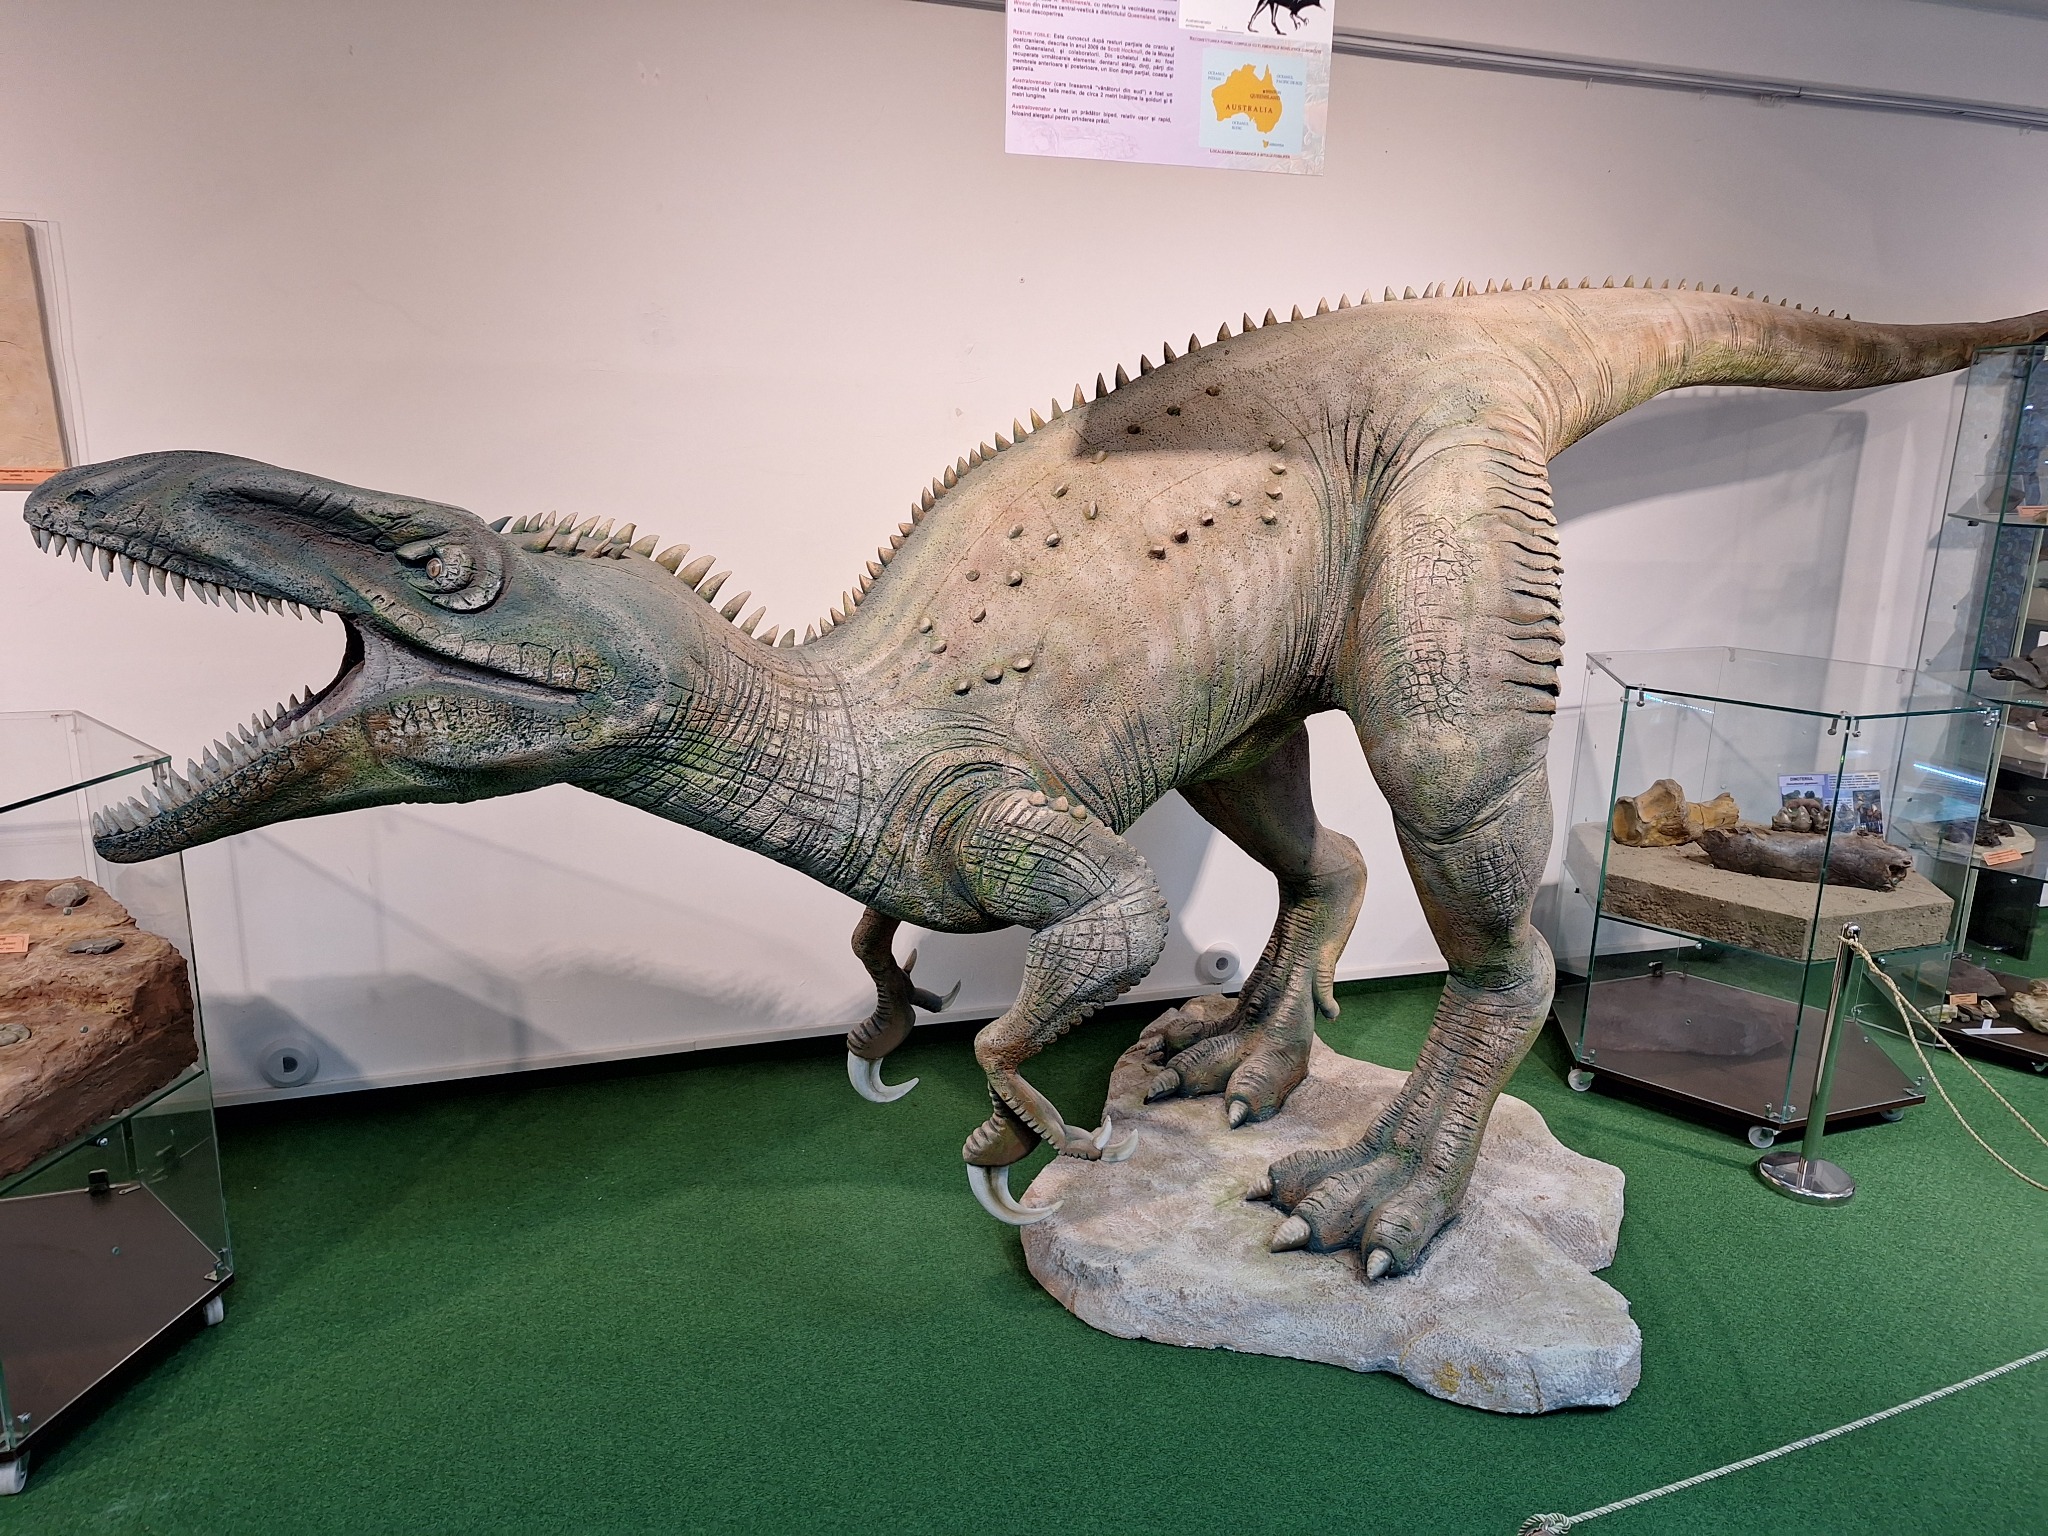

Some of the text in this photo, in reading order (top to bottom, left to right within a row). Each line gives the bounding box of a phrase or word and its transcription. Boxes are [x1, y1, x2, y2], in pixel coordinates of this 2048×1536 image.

[1013, 77, 1051, 85] Australovenator
[1012, 104, 1050, 112] Australovenator
[1226, 104, 1273, 113] AUSTRALIA
